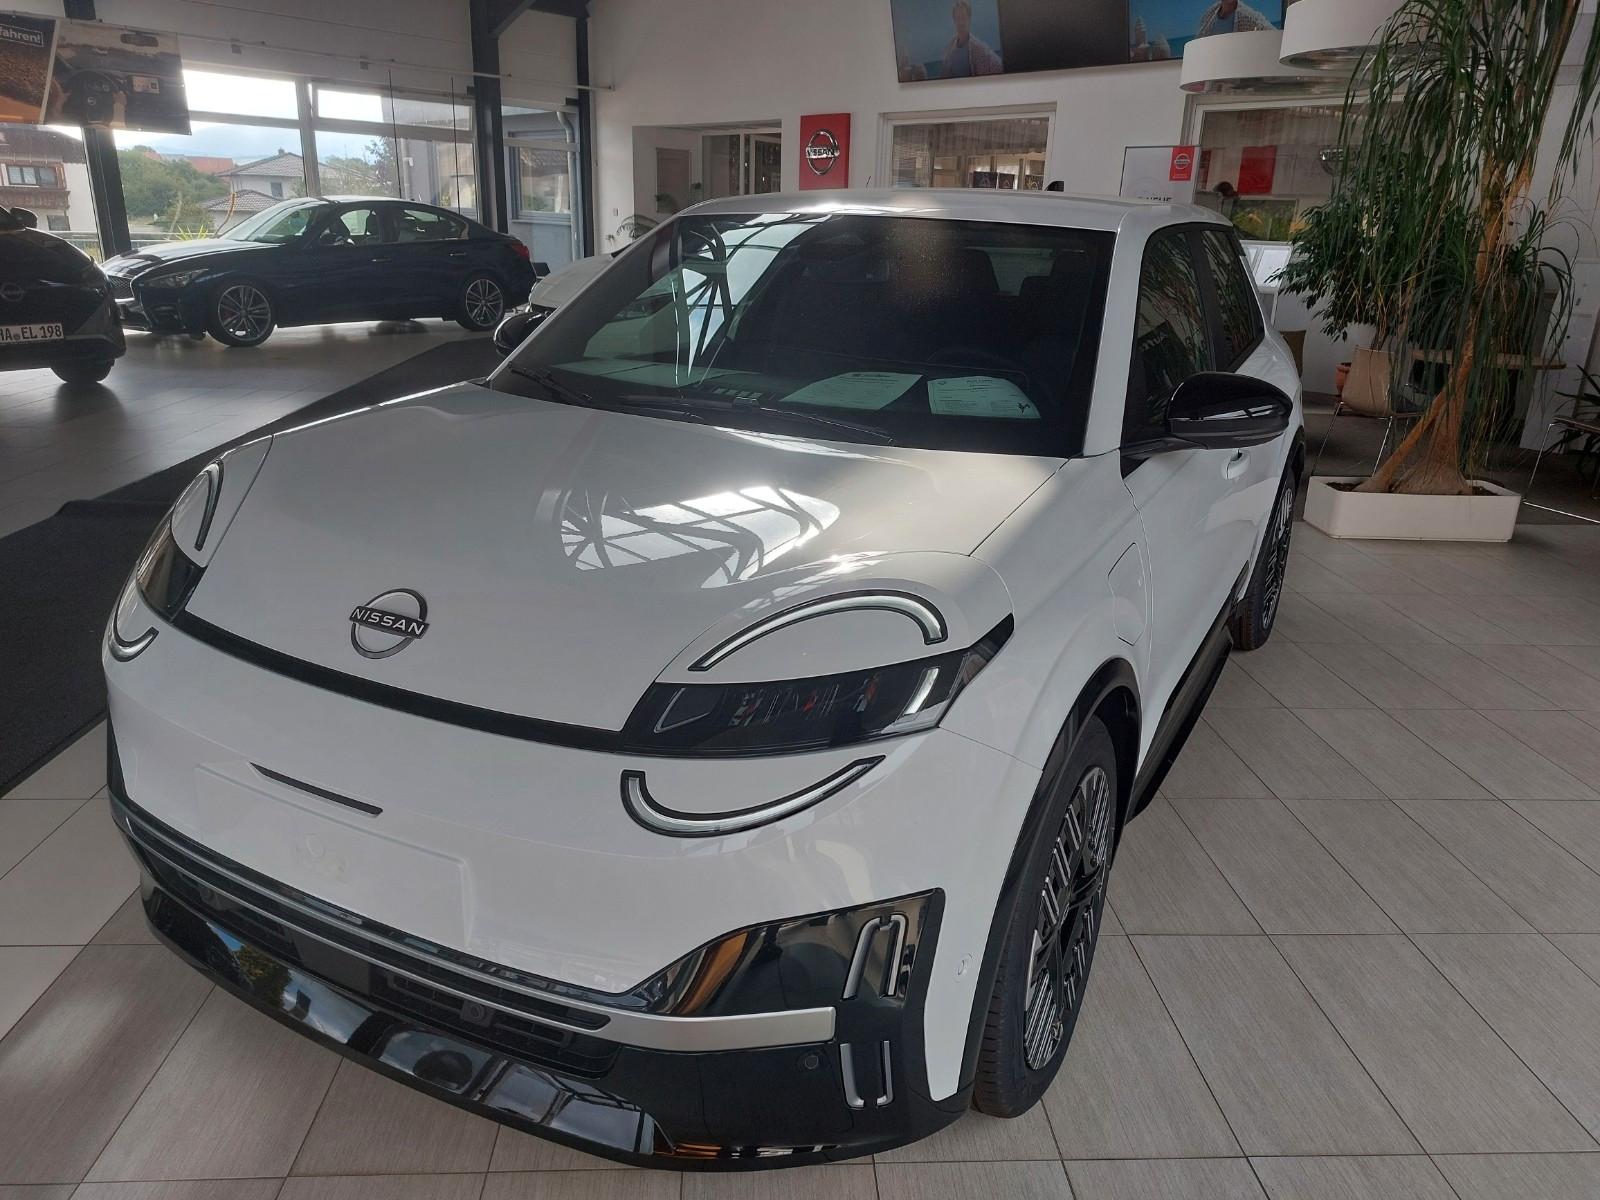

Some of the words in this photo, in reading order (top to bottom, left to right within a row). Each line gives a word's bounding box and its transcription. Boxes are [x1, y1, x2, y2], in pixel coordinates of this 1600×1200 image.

[21, 326, 38, 339] EL
[40, 325, 61, 338] 198
[352, 608, 424, 635] NISSAN
